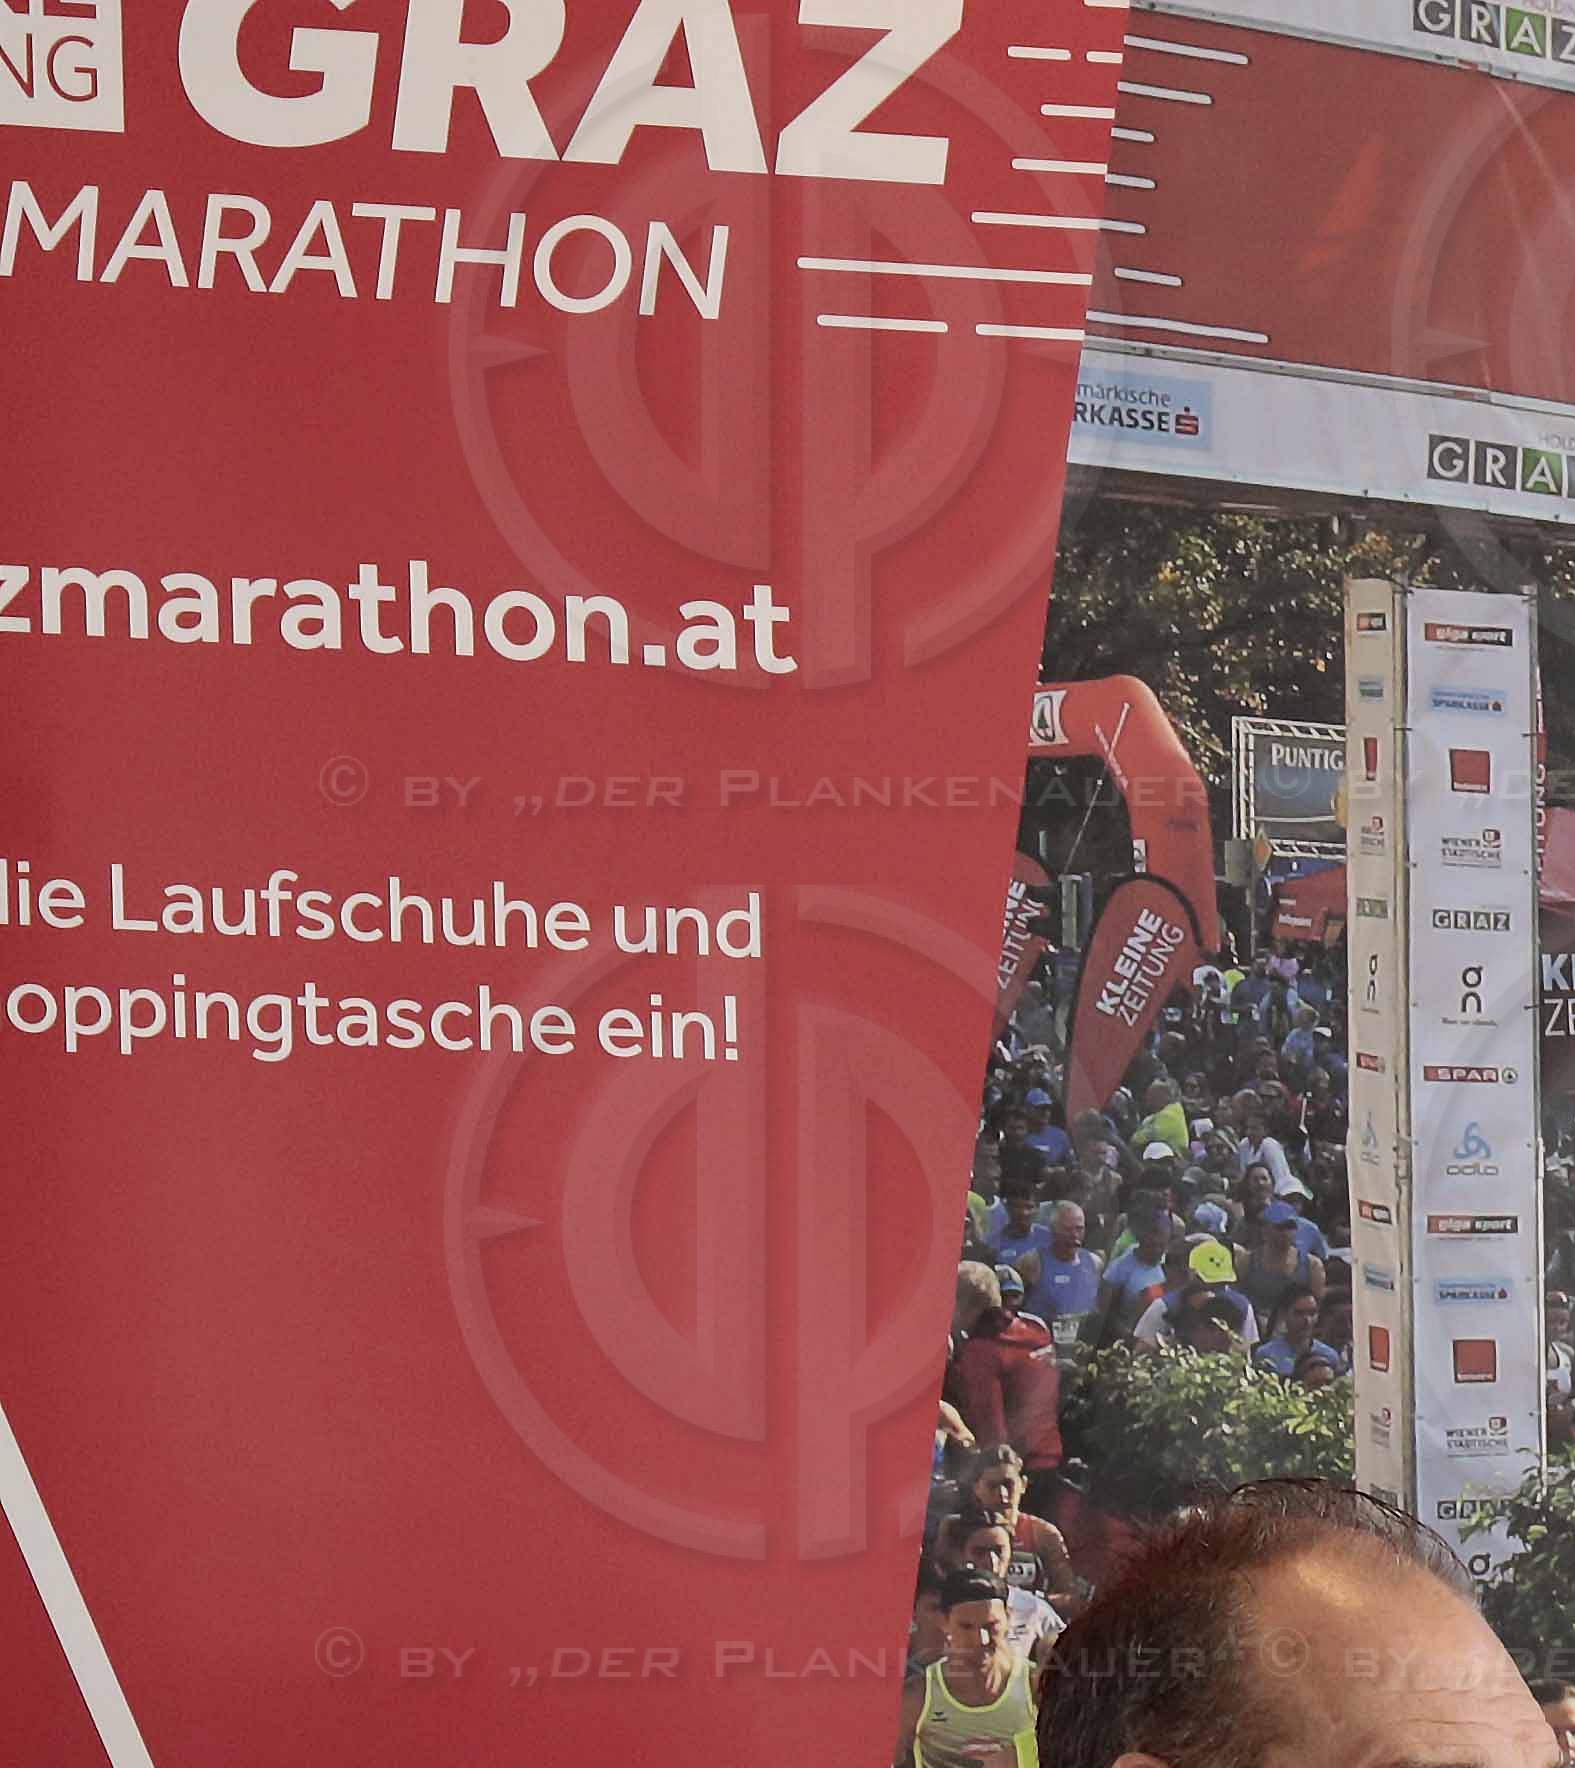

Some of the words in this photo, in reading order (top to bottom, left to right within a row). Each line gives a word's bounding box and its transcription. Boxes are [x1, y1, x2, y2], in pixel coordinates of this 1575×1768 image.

[177, 0, 967, 185] GRAZ
[0, 180, 730, 320] MARATHON
[0, 560, 798, 674] zmarathon.at
[110, 862, 591, 950] Laufschuhe
[613, 890, 763, 959] und
[1096, 908, 1164, 1017] KLEINE
[1433, 909, 1510, 931] GRAZ
[1116, 922, 1186, 1027] ZEITUNG
[597, 994, 742, 1061] ein!
[1438, 1067, 1498, 1082] SPAR
